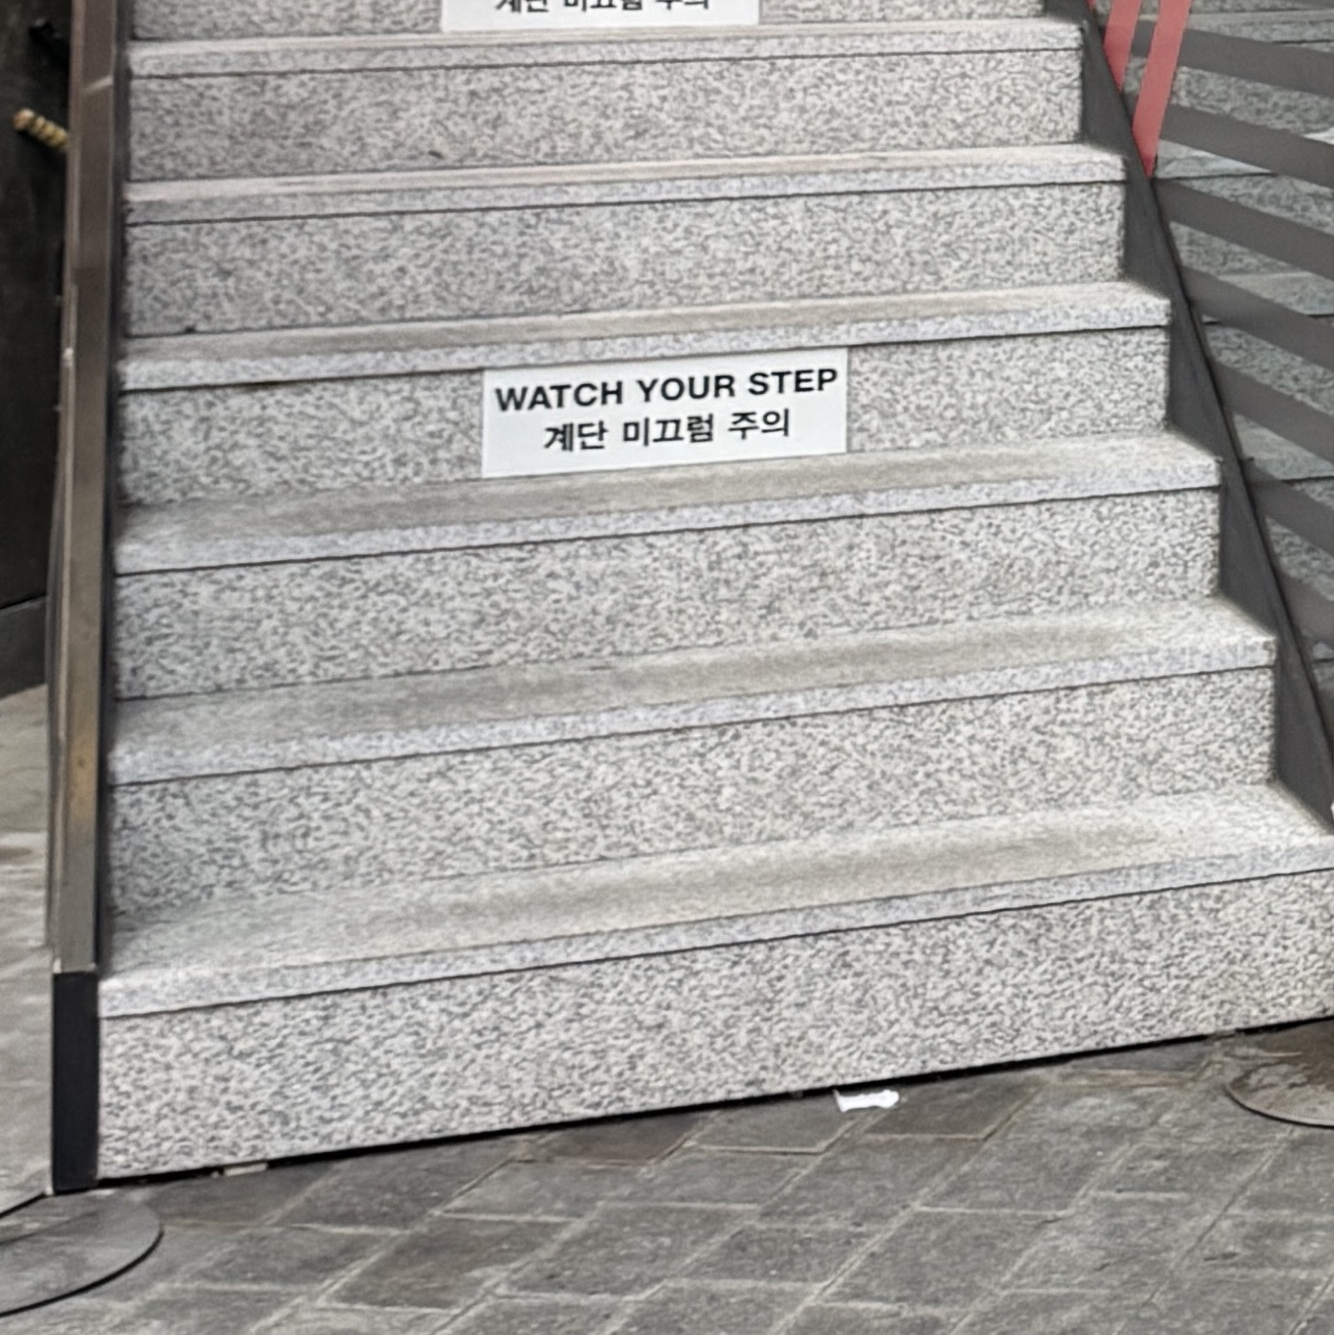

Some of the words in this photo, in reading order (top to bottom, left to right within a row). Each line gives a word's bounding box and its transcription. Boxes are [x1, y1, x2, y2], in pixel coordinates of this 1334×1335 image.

[495, 380, 623, 412] WATCH
[637, 375, 736, 403] YOUR
[748, 368, 838, 396] STEP
[544, 420, 608, 453] 계단
[622, 413, 714, 447] 미끄럼
[728, 408, 790, 440] 주의
